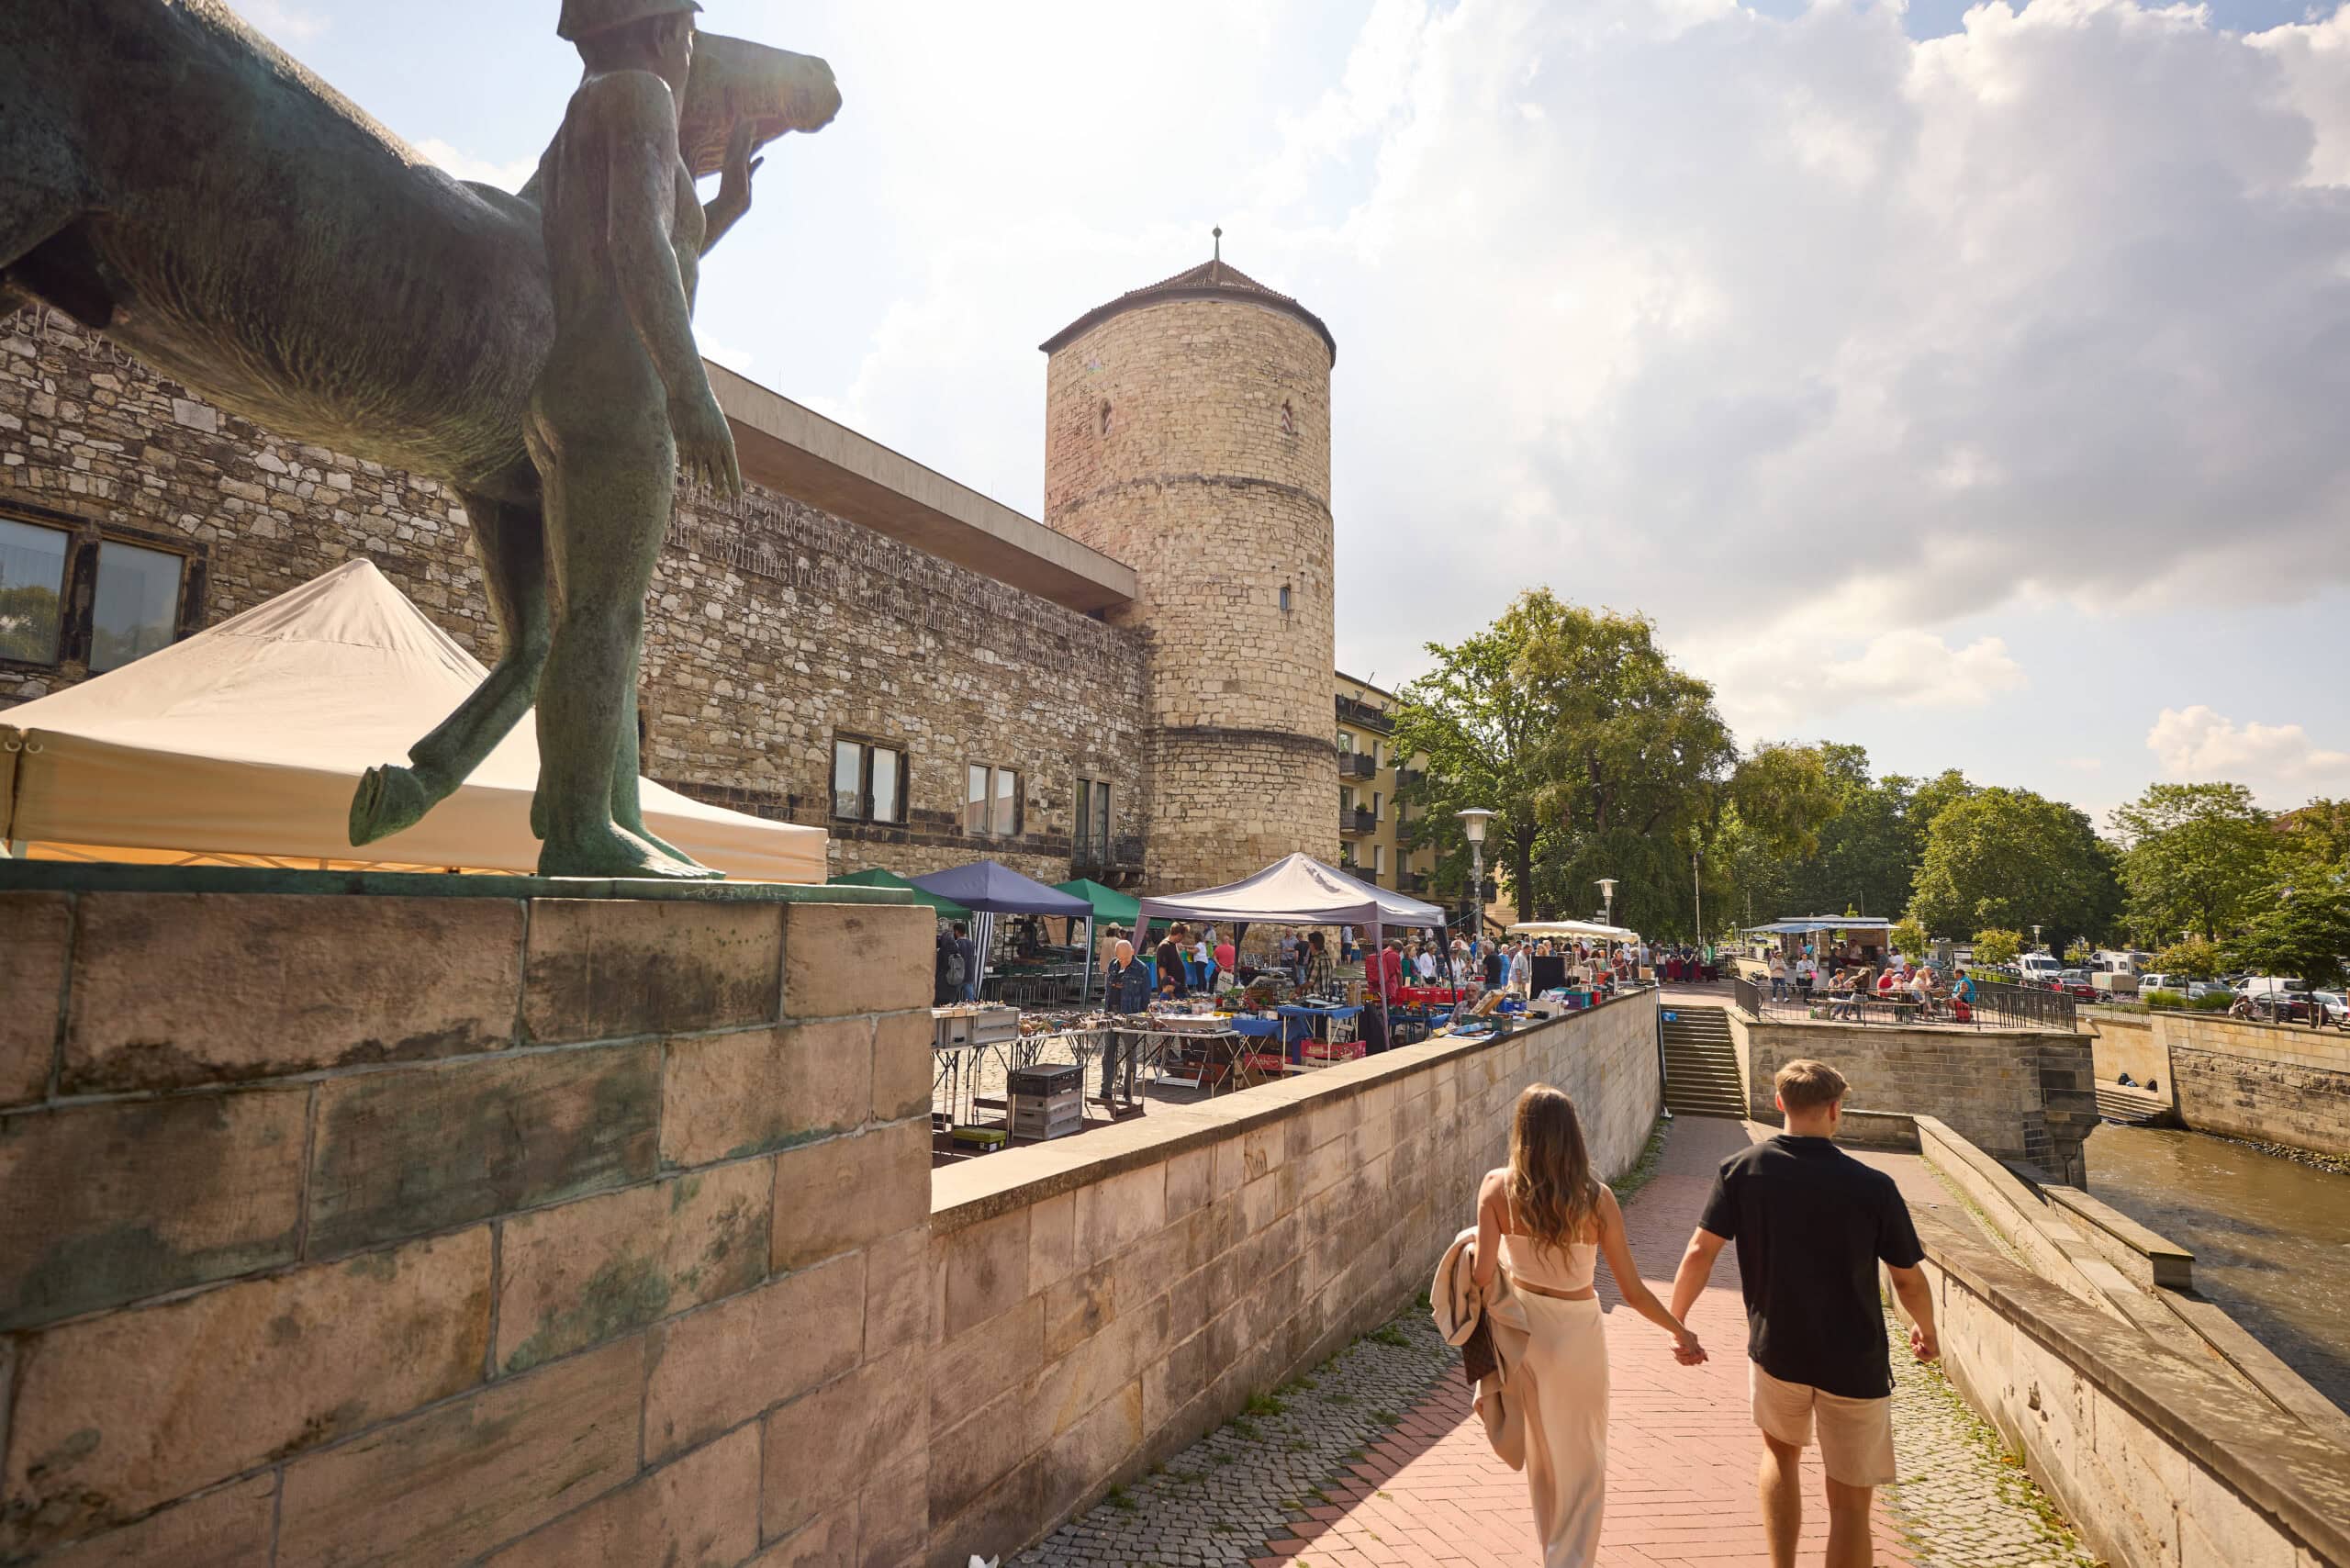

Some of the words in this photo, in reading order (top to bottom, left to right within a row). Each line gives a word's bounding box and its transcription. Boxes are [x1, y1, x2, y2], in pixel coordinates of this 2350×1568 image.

[698, 519, 792, 584] Gewimmel
[795, 563, 823, 592] von
[764, 502, 808, 544] außer
[812, 516, 850, 557] einer
[990, 588, 1010, 617] wie
